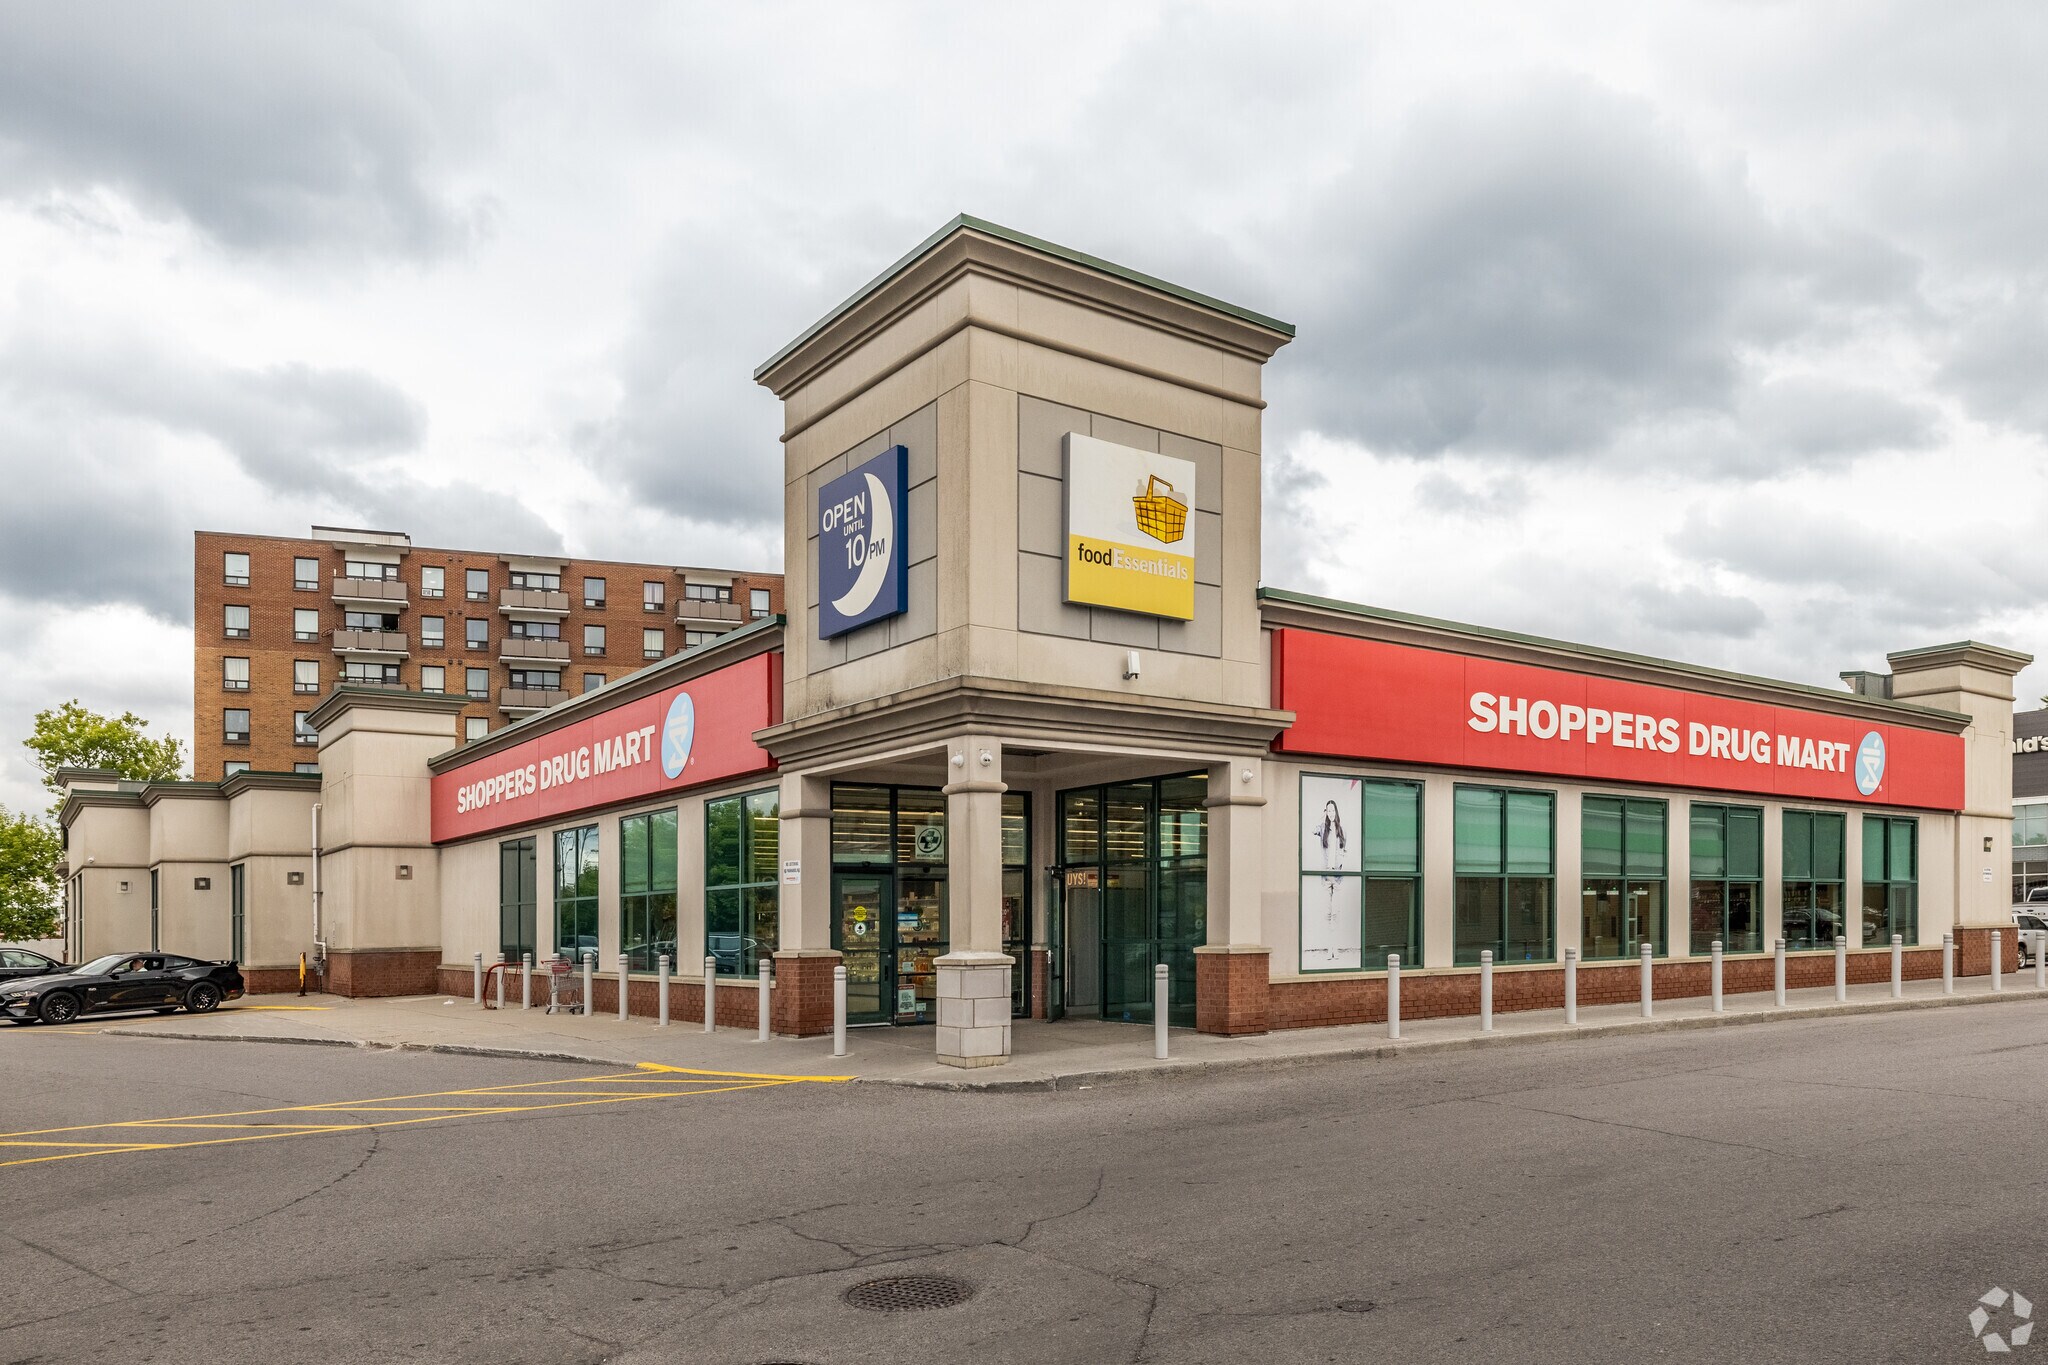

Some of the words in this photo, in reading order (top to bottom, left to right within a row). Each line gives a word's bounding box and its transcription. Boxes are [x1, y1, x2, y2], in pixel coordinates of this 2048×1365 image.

[823, 491, 865, 532] OPEN
[843, 519, 865, 536] UNTIL
[845, 534, 866, 569] 10
[869, 538, 885, 559] PM
[1467, 692, 1681, 753] SHOPPERS
[1688, 722, 1771, 764] DRUG
[1777, 734, 1851, 773] MART
[457, 764, 536, 814] SHOPPERS
[540, 746, 590, 790] DRUG
[594, 725, 656, 775] MART
